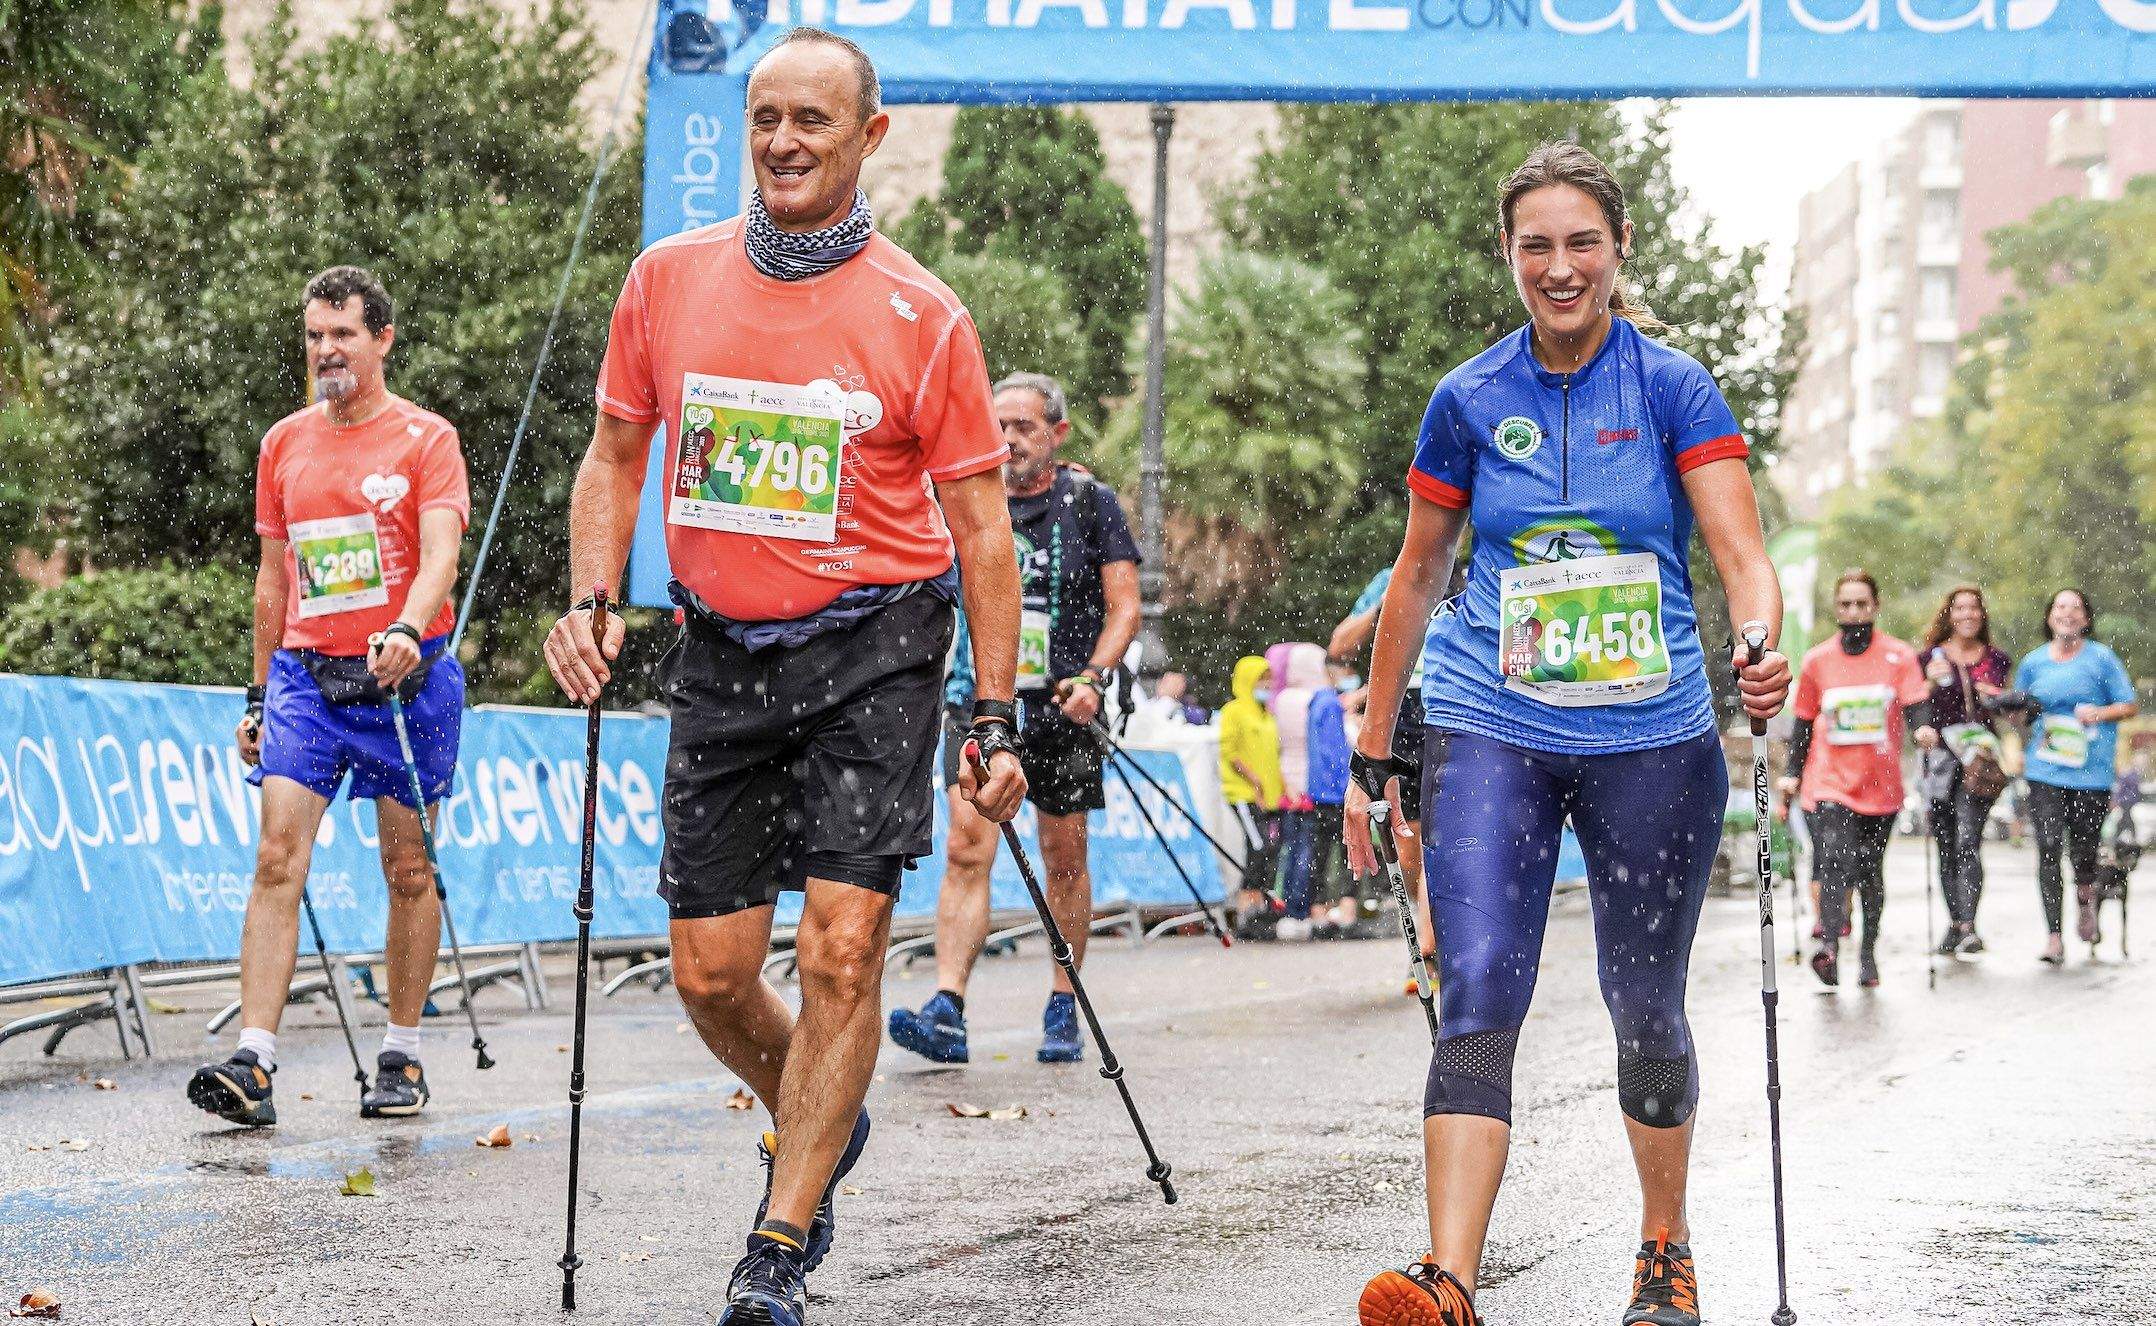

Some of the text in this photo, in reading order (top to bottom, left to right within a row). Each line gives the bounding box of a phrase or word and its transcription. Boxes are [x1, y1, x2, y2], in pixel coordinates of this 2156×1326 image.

[703, 388, 740, 400] CaixaBank
[760, 396, 786, 406] aecc
[681, 464, 703, 479] MAR
[714, 436, 830, 495] 4796
[680, 475, 701, 489] CHA
[1523, 570, 1602, 588] CaixaBank aecc
[1544, 609, 1656, 666] 6458
[1508, 653, 1533, 664] MAR
[1508, 664, 1533, 677] CHA
[350, 755, 661, 848] aservce
[0, 735, 335, 893] aquaserv
